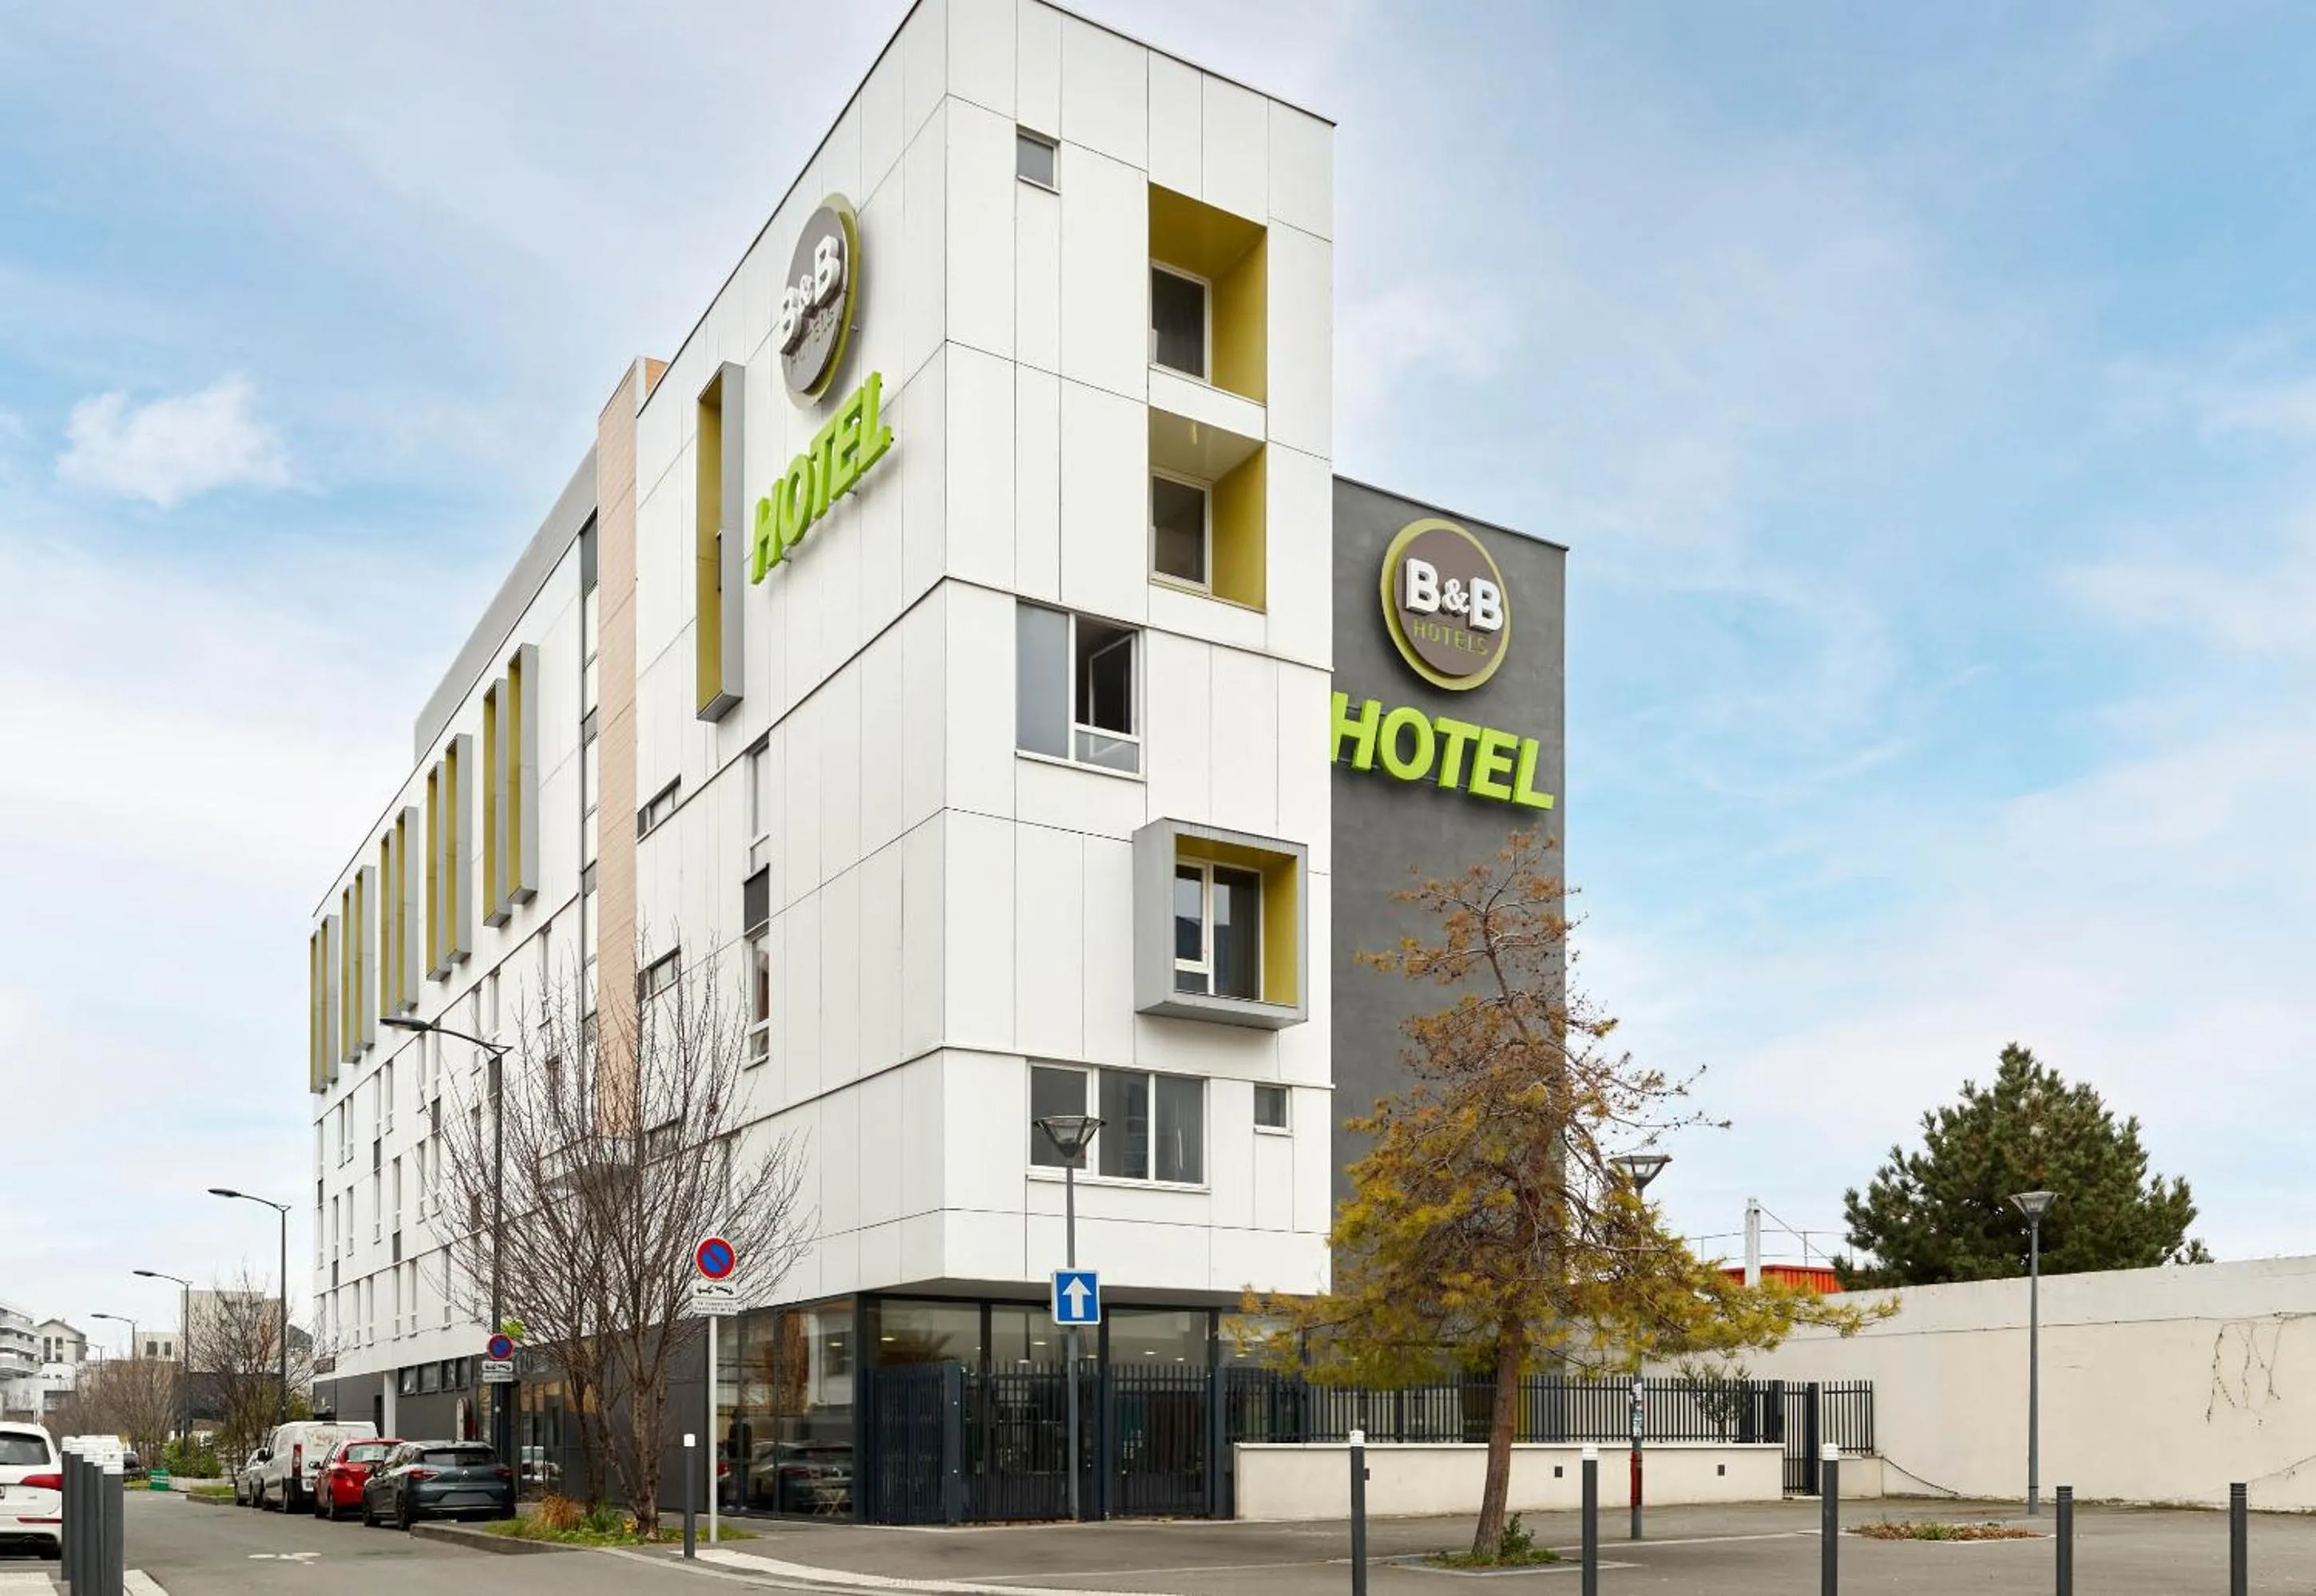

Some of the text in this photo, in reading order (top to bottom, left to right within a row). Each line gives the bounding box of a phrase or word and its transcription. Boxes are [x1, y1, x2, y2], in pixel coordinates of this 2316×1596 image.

[779, 234, 840, 354] B&B
[752, 371, 892, 585] HOTEL
[1406, 557, 1504, 632] B&B
[1412, 618, 1489, 655] HOTELS
[1331, 690, 1554, 810] HOTEL
